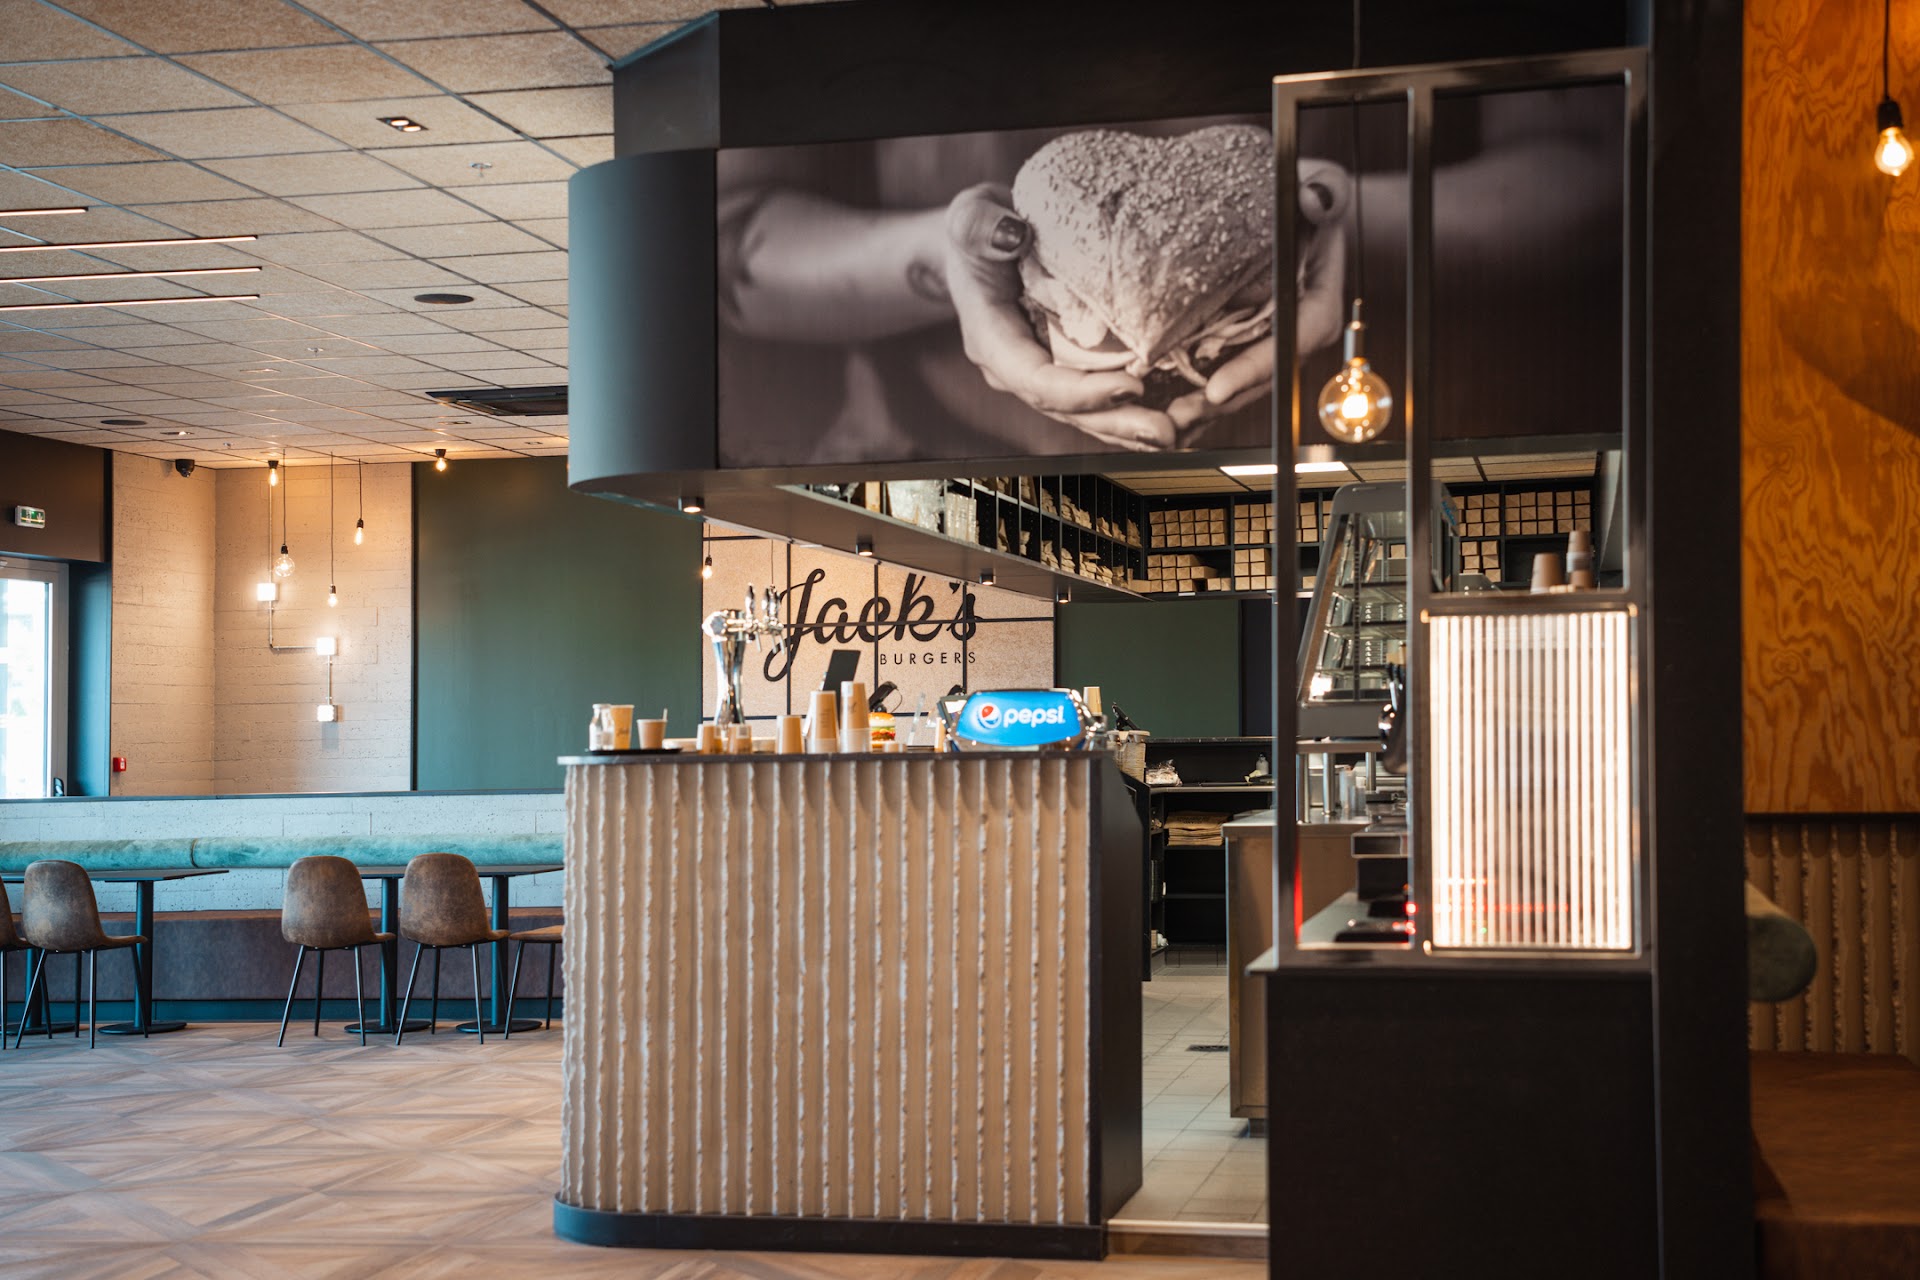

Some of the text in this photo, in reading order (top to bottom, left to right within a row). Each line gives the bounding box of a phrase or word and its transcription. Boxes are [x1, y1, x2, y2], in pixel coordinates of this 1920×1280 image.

[763, 568, 984, 682] Jack's
[879, 651, 976, 665] BURGERS
[1003, 705, 1064, 728] pepsi
